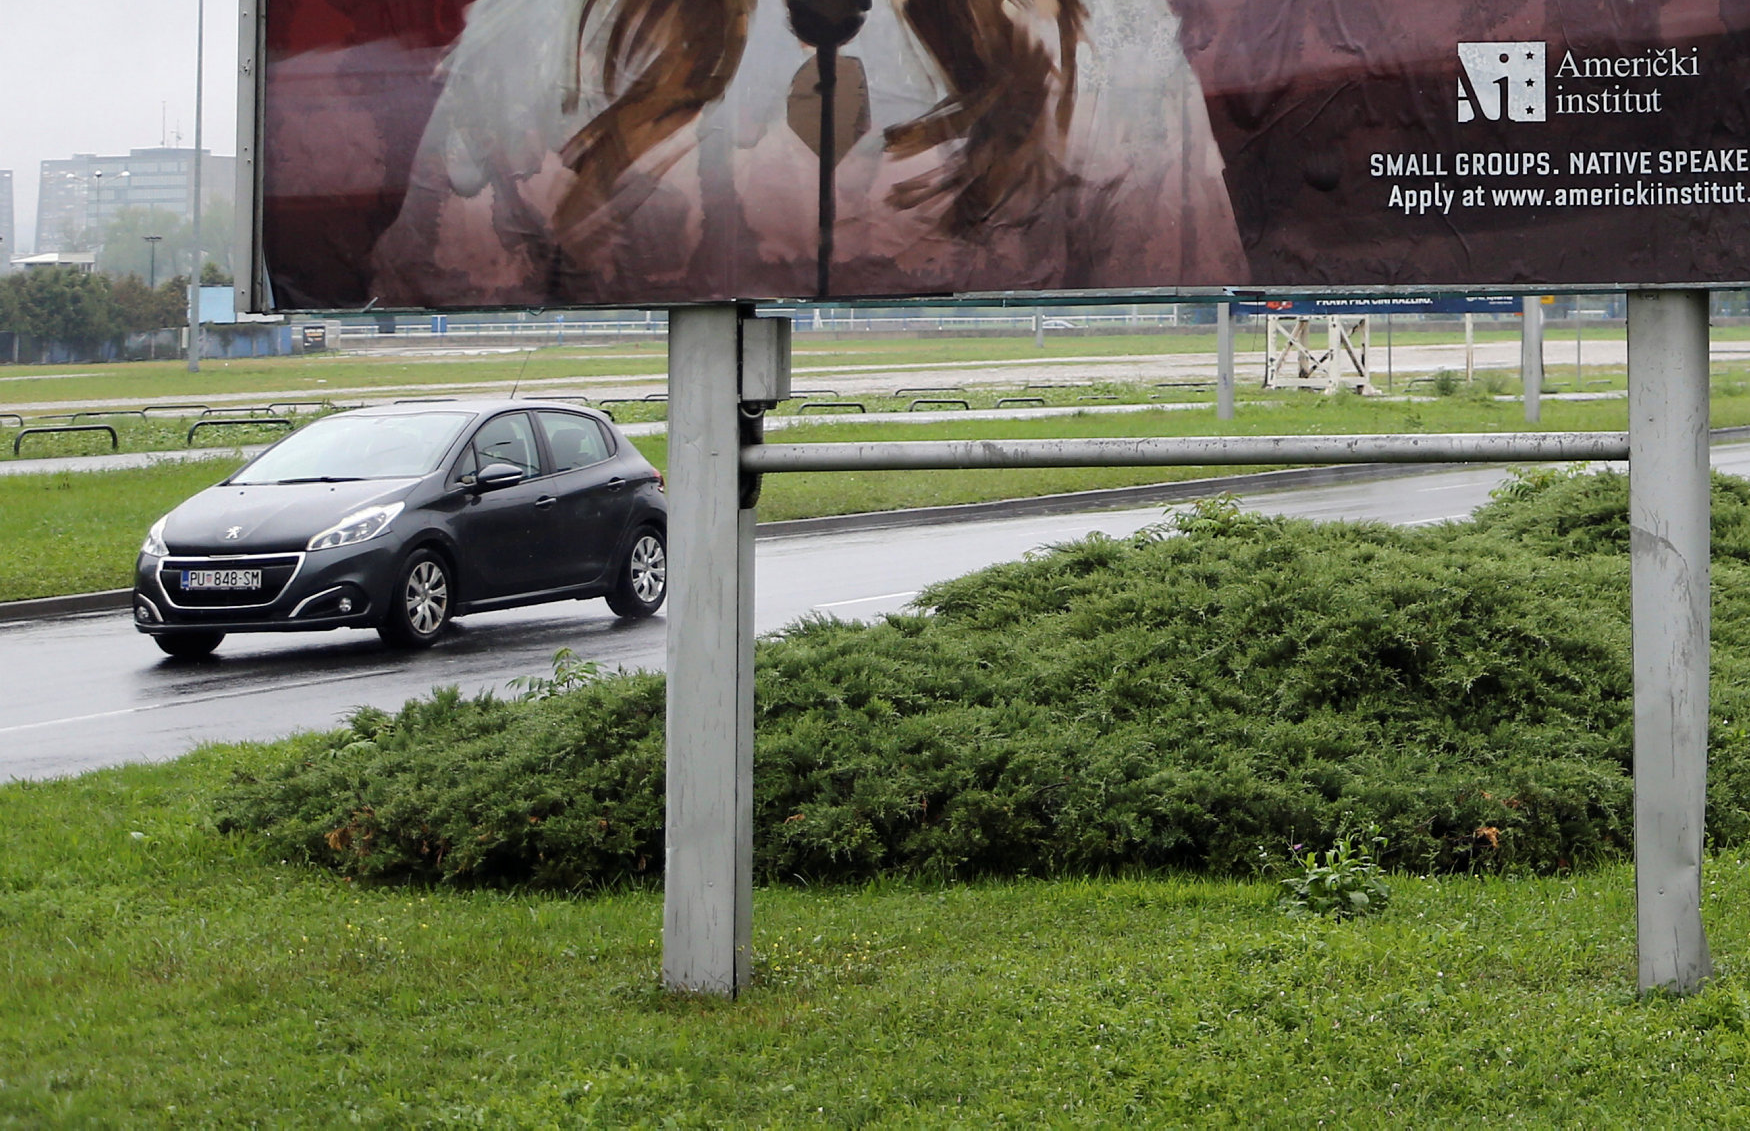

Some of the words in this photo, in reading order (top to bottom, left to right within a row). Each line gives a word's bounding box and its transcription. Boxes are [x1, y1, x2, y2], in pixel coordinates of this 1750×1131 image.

[1555, 47, 1700, 79] Američki
[1555, 85, 1663, 114] institut
[1370, 154, 1449, 177] SMALL
[1455, 152, 1559, 176] GROUPS.
[1569, 151, 1651, 175] NATIVE
[1388, 182, 1455, 214] Apply
[1462, 186, 1485, 207] at
[190, 571, 205, 586] PU
[214, 571, 260, 586] 848-SM
